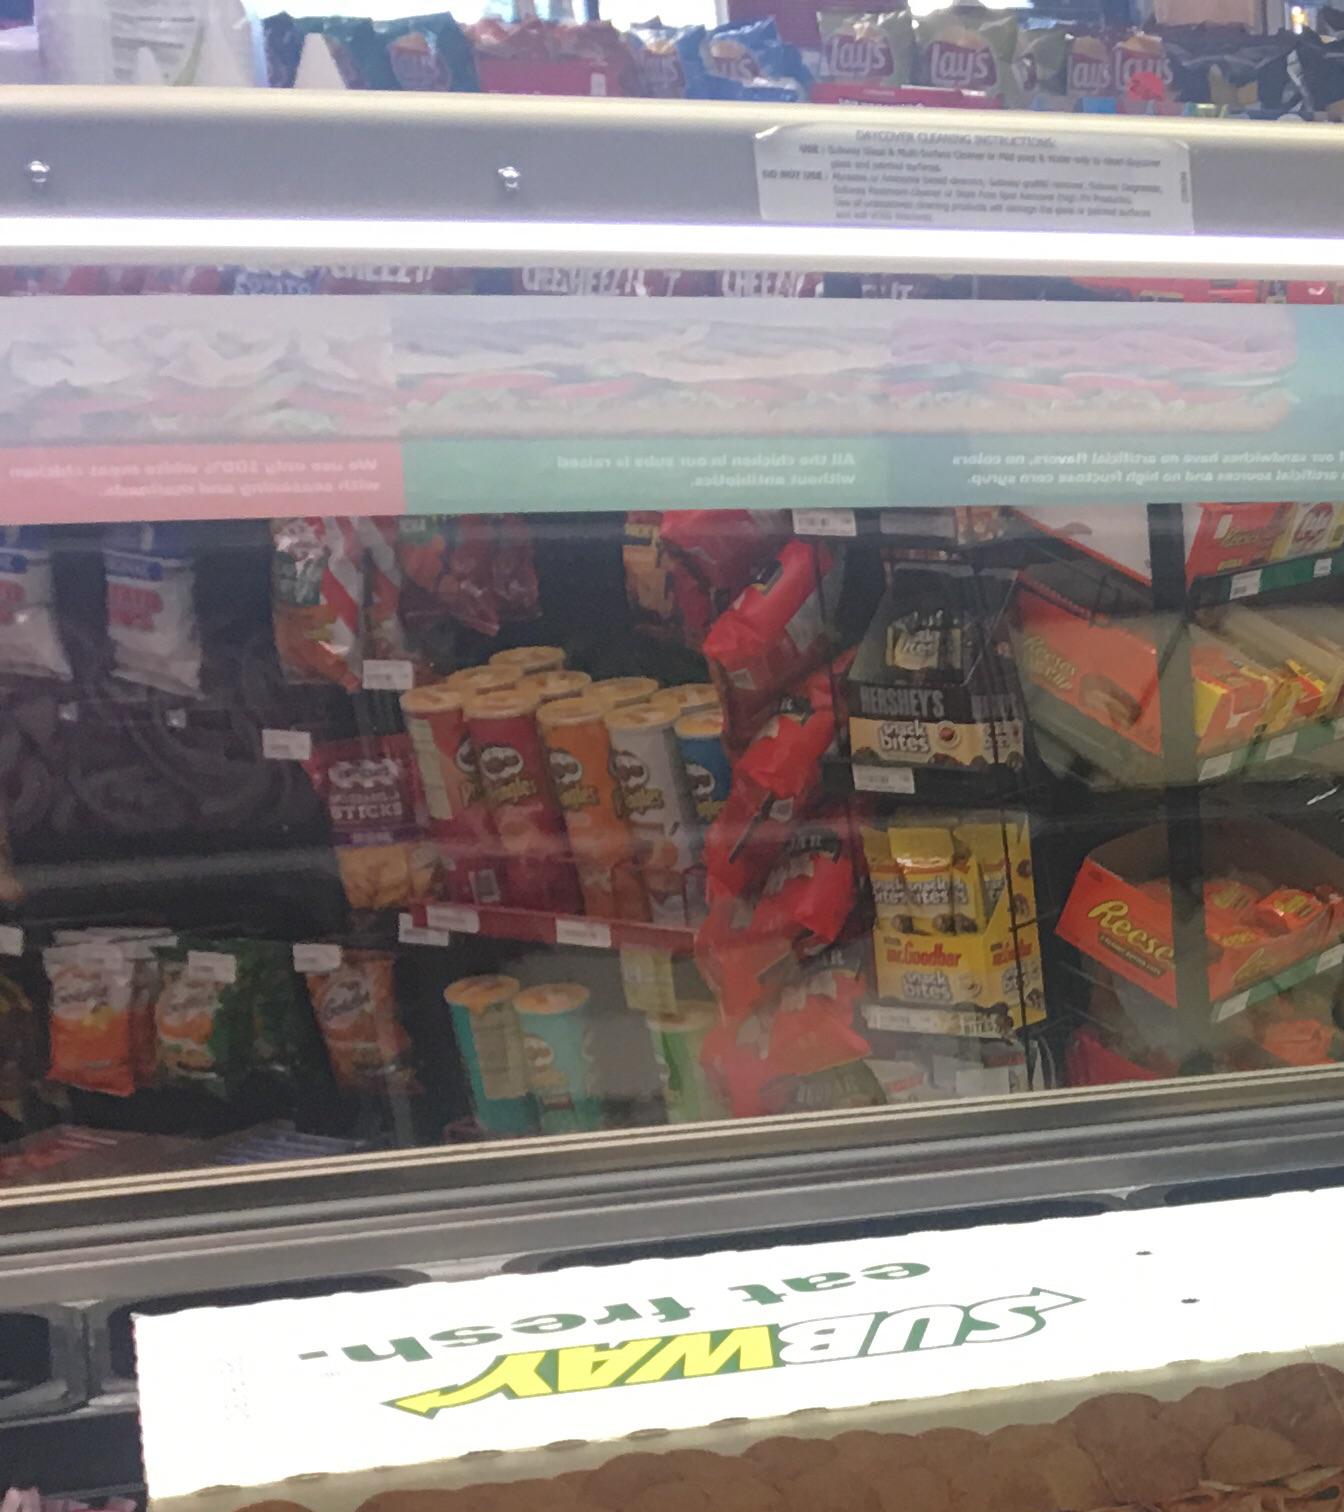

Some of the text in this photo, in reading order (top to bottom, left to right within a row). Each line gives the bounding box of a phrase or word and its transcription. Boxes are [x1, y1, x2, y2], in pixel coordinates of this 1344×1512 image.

[859, 686, 945, 718] HERSHEY'S
[880, 734, 930, 752] bites
[329, 802, 403, 820] STICKS
[903, 982, 951, 1001] bites
[297, 1261, 932, 1364] eat fresh.
[381, 1286, 1087, 1419] SUBWAY
